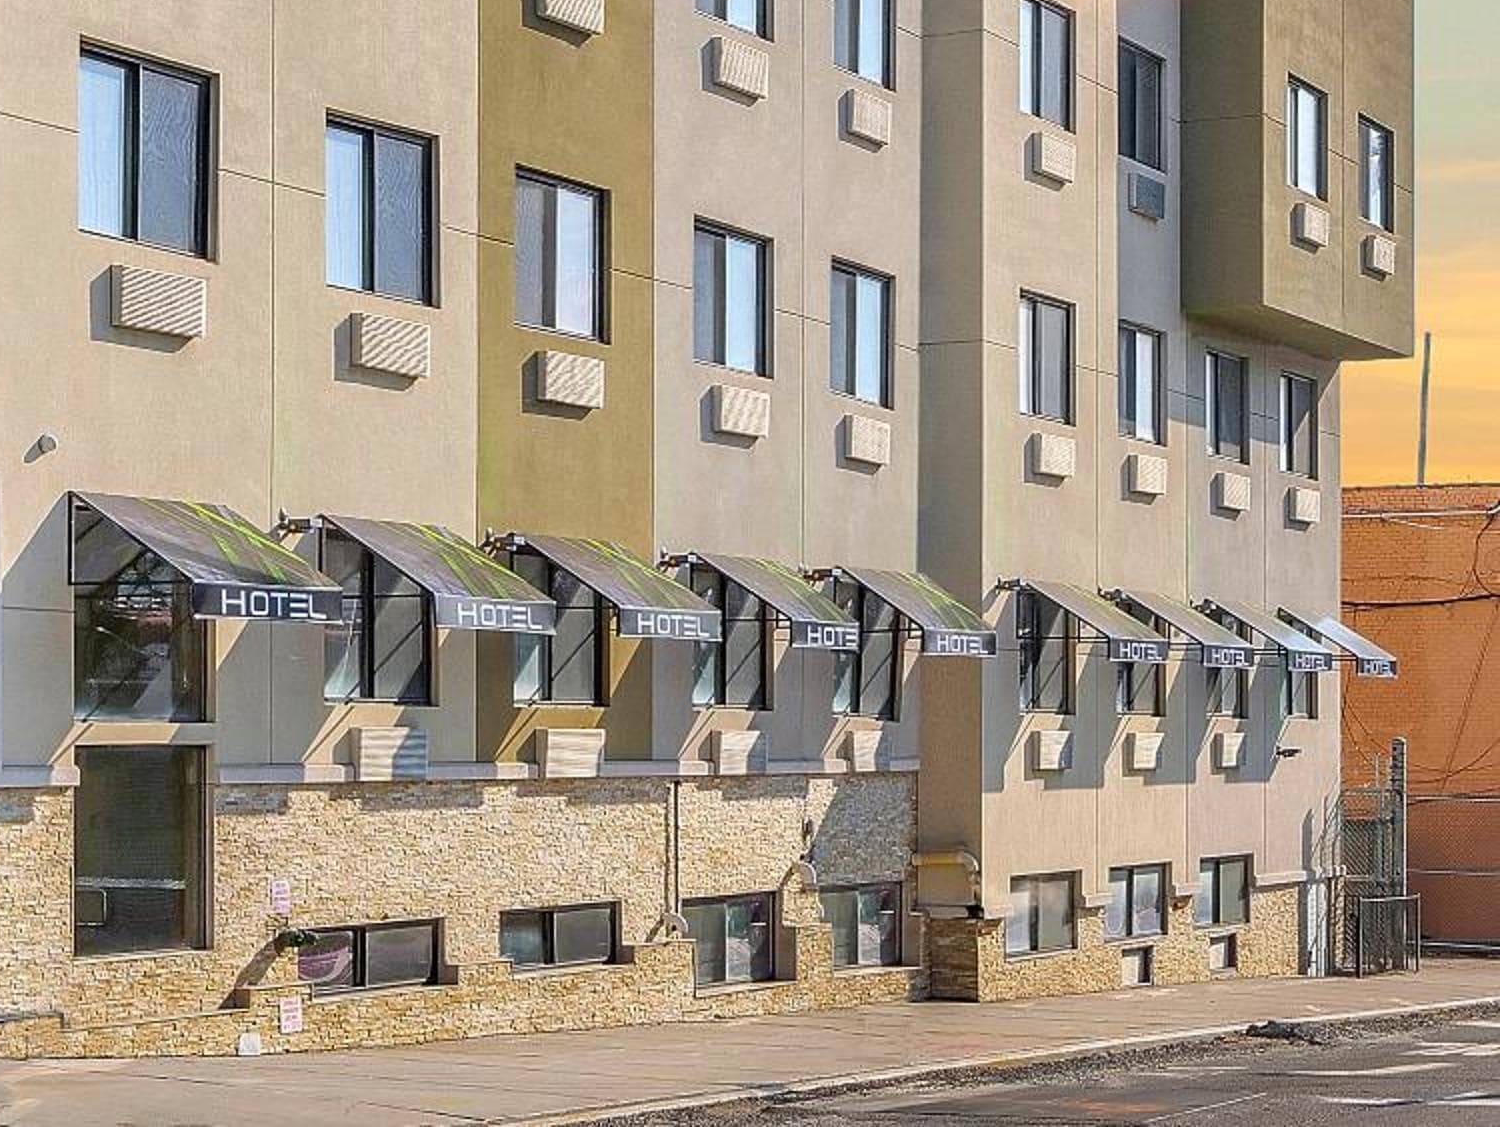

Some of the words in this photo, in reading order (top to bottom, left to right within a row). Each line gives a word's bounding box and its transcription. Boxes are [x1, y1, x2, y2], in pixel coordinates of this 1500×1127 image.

[221, 588, 328, 619] HOTEL
[457, 602, 543, 630] HOTEL
[637, 612, 710, 638] HOTEL
[937, 634, 989, 654] HOTEL
[1119, 642, 1162, 661] HOTEL
[1211, 648, 1249, 666] HOTEL
[1295, 653, 1330, 670] HOTEL
